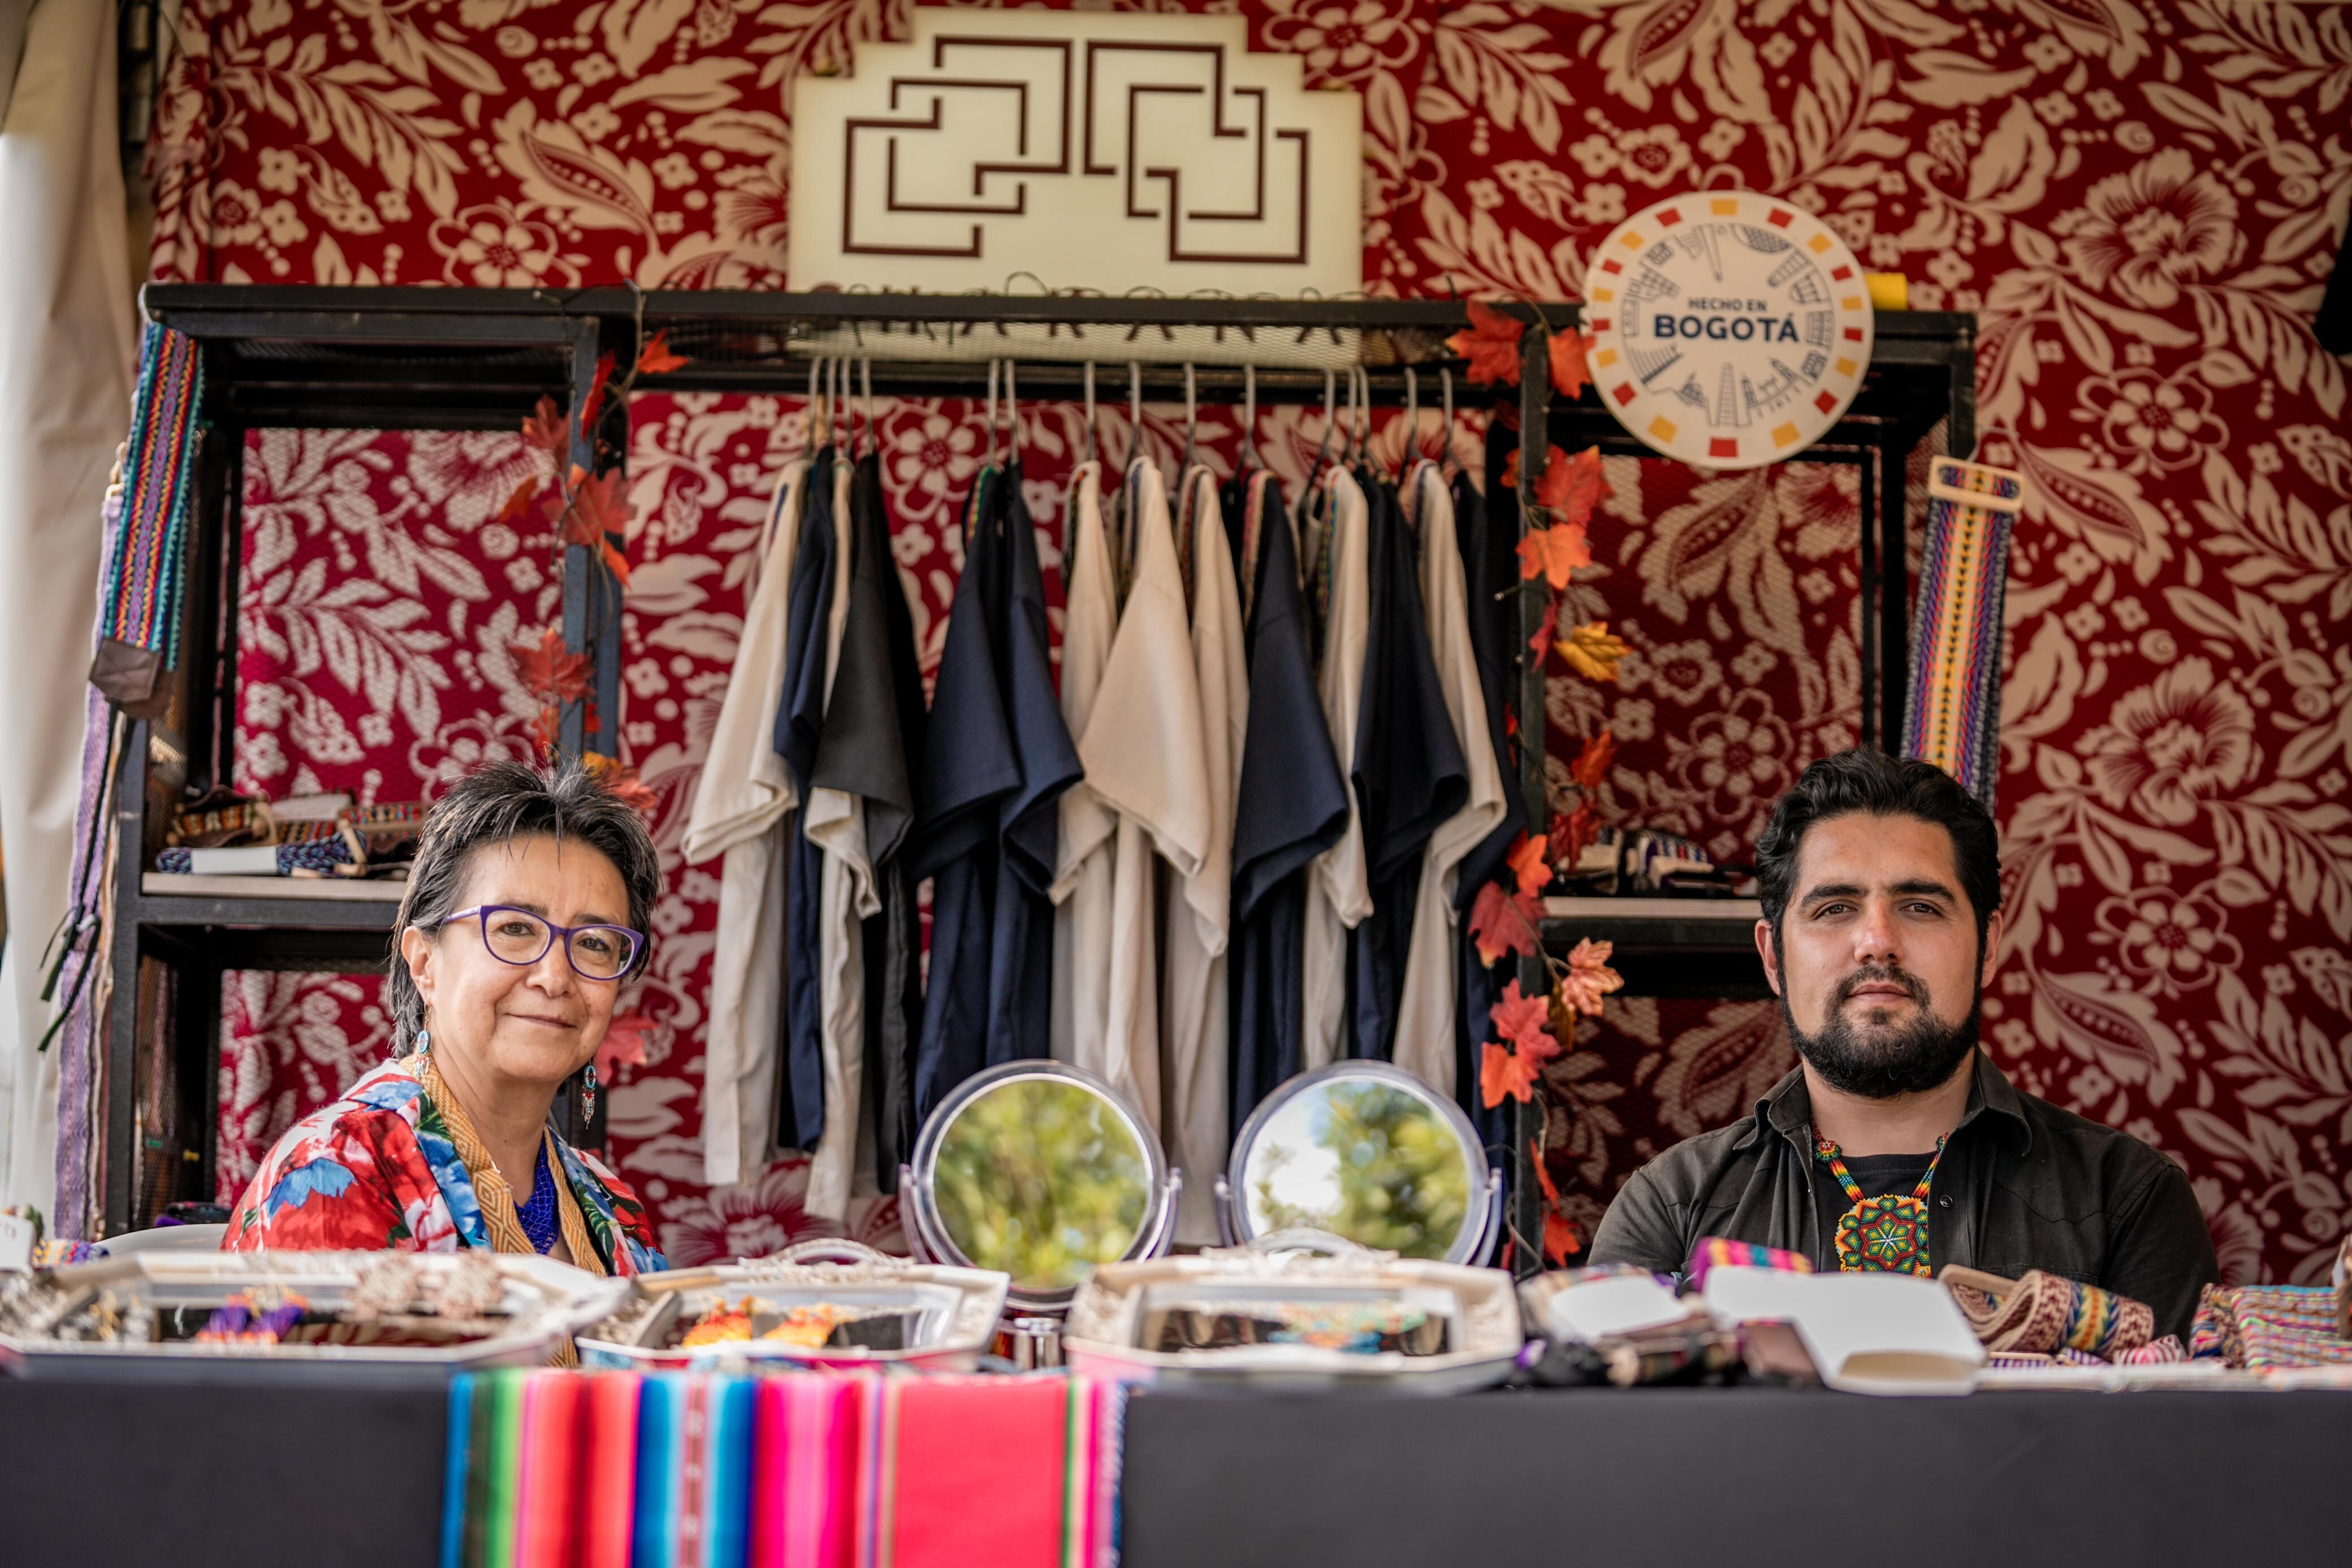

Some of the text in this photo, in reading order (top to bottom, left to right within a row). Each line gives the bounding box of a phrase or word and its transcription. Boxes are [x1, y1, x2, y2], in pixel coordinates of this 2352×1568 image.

[1688, 297, 1767, 311] HECHO EN
[1654, 311, 1800, 342] BOGOTÁ
